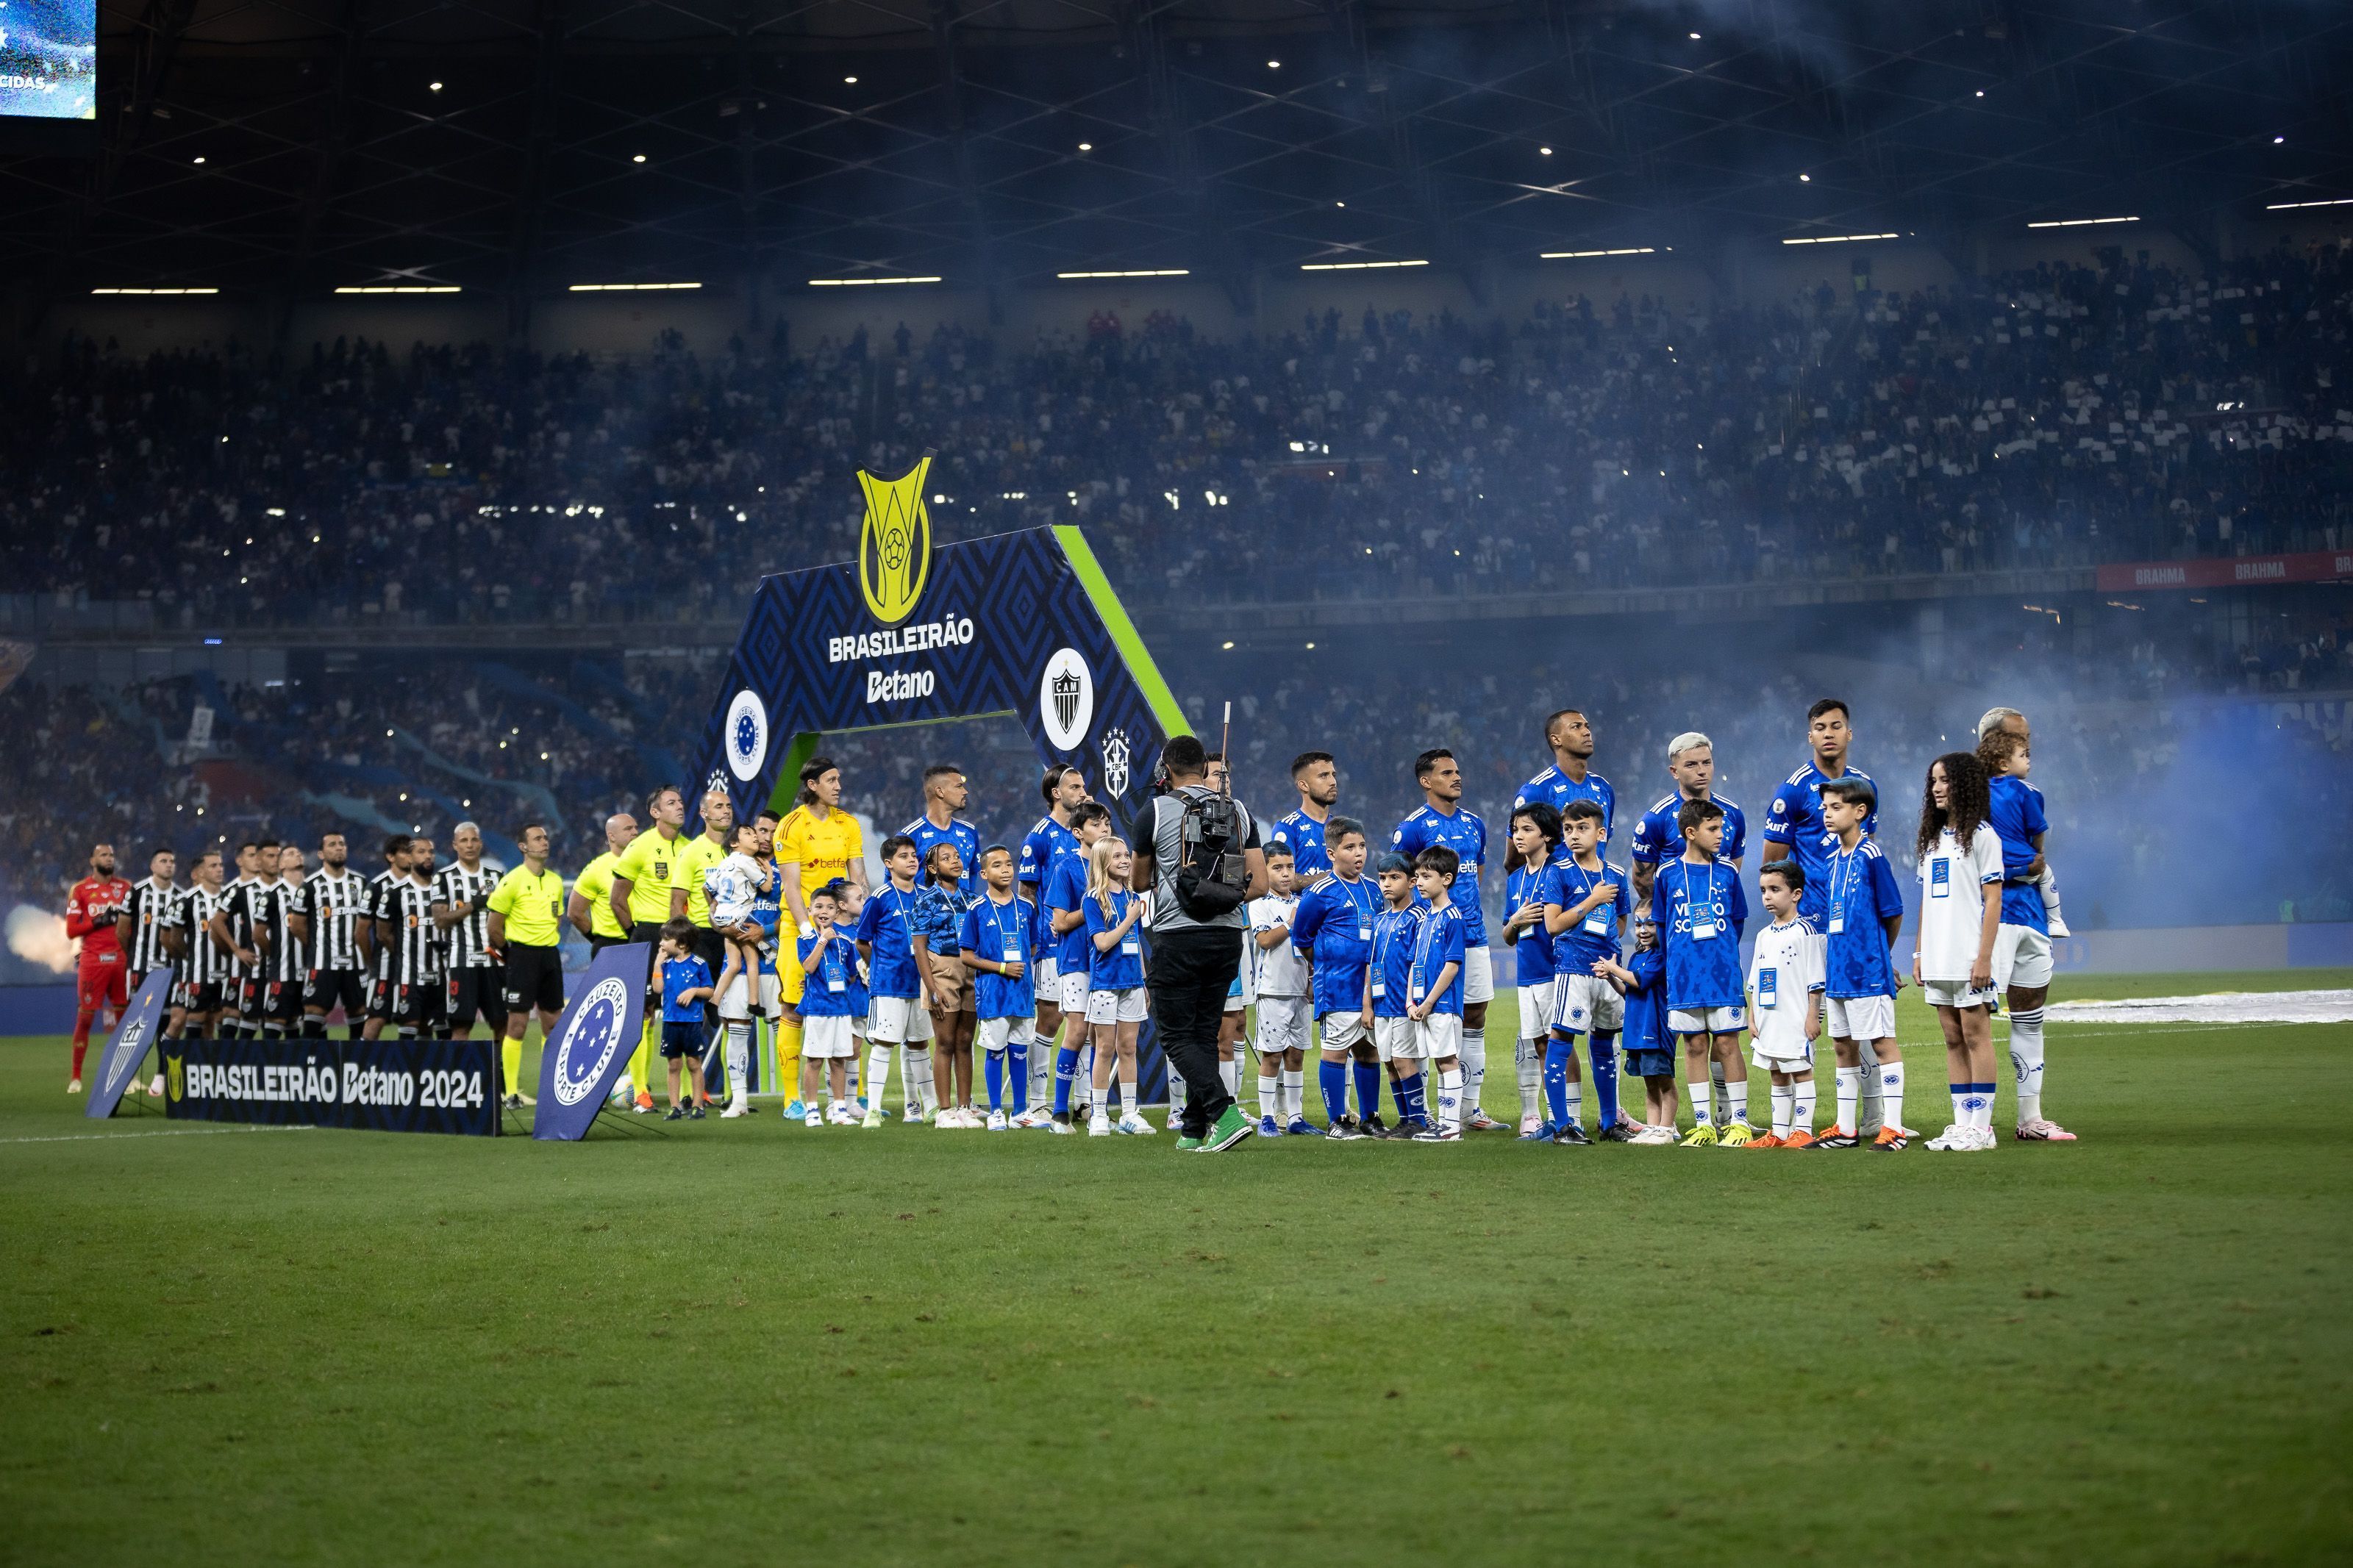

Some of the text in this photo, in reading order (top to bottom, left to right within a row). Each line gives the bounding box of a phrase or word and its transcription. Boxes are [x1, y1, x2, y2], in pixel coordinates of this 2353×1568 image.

[2235, 562, 2285, 580] BRAHMA
[2335, 556, 2353, 573] BR
[2135, 568, 2185, 585] BRAHMA
[829, 613, 974, 662] BRASILEIRÃO
[867, 670, 935, 704] Betano
[1056, 681, 1077, 693] CAM
[1112, 763, 1121, 771] CBF
[1765, 817, 1789, 834] Surf
[1632, 836, 1651, 854] Surf
[820, 858, 846, 868] betfa
[1019, 864, 1036, 874] Surf
[579, 984, 623, 1020] CRUZEIRO
[557, 1030, 618, 1100] ESPORTE CLUBE
[187, 1056, 484, 1109] BRASILEIRÃO Betano 2024
